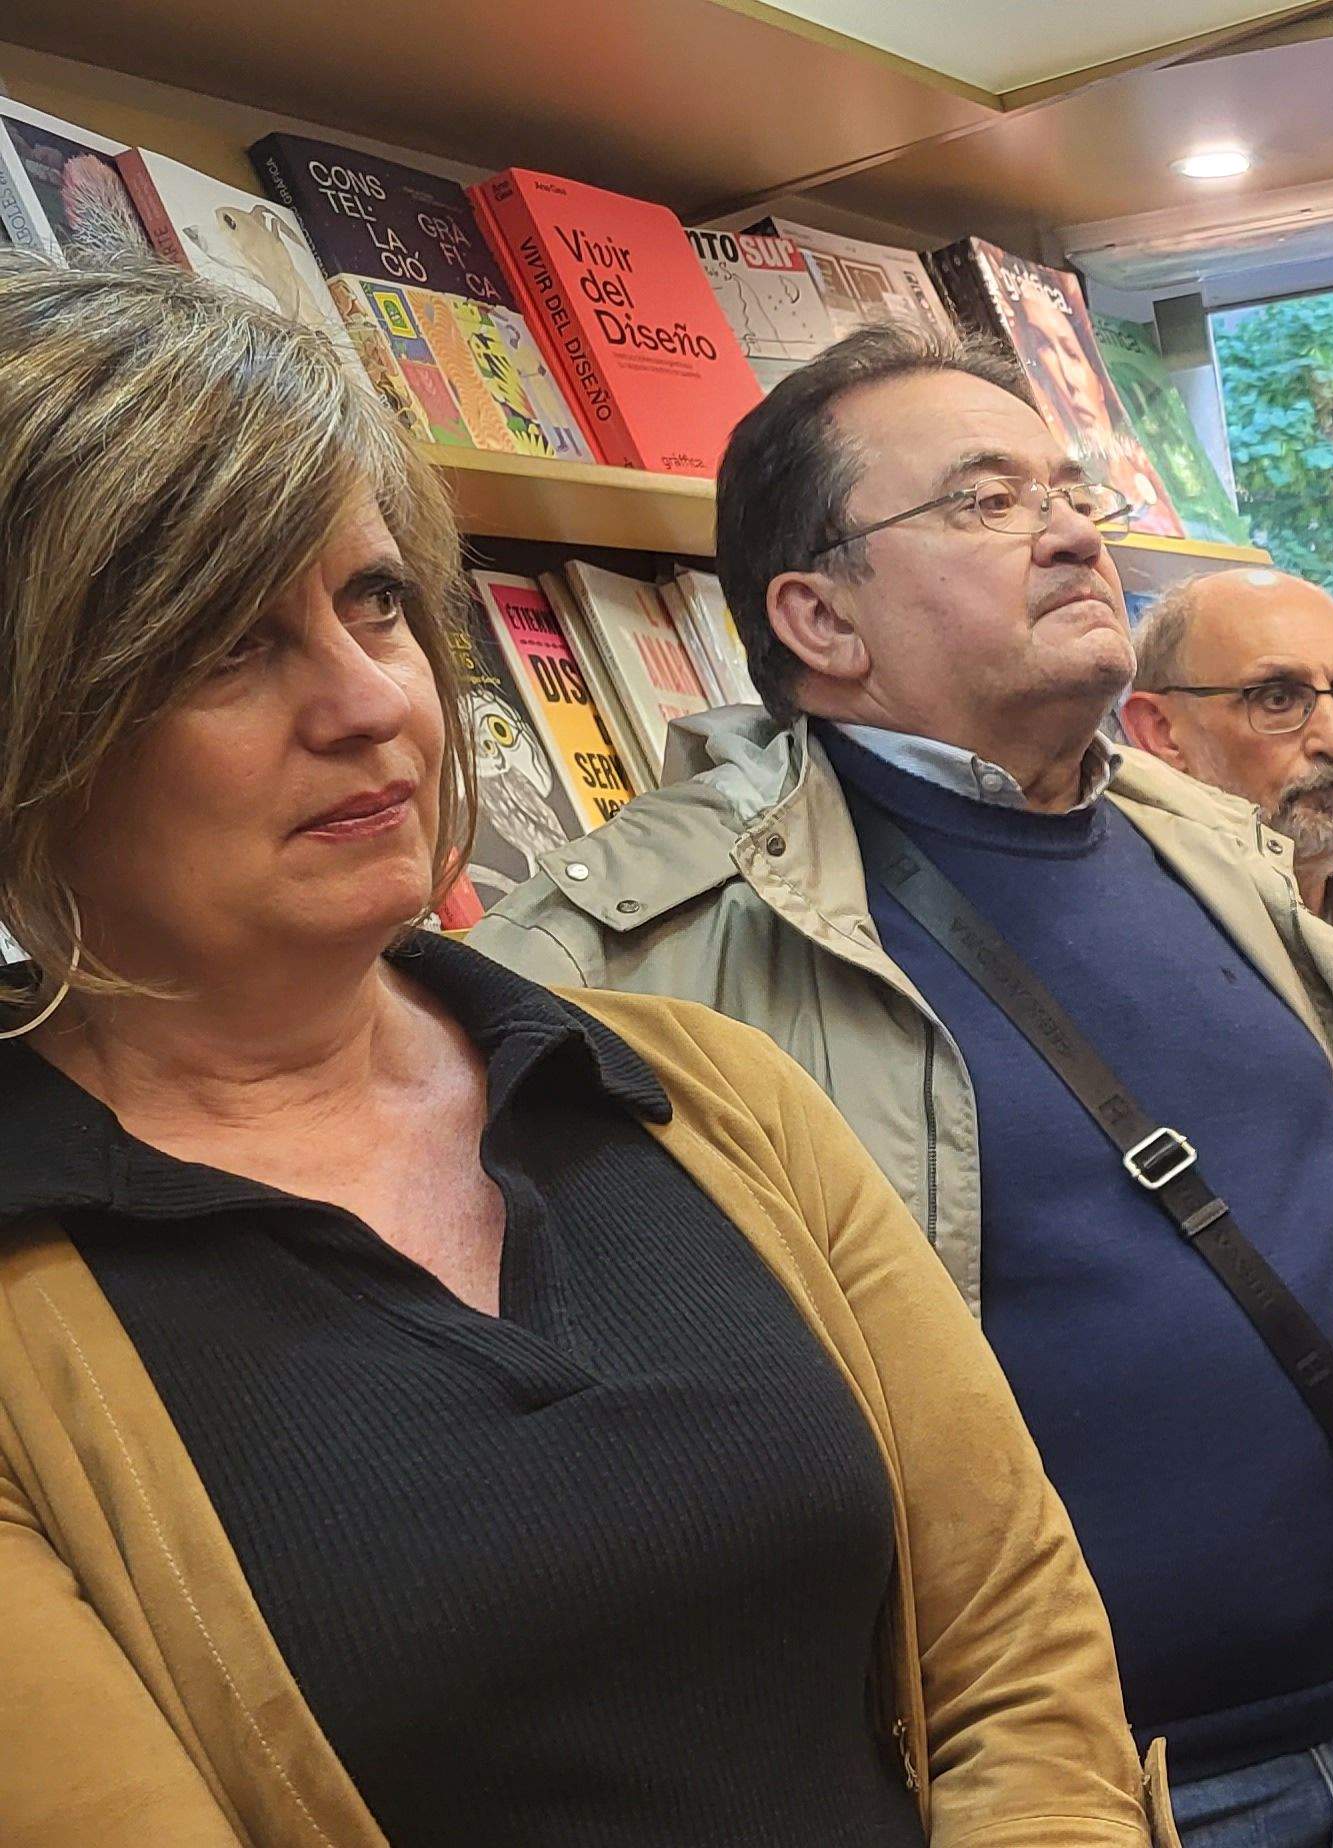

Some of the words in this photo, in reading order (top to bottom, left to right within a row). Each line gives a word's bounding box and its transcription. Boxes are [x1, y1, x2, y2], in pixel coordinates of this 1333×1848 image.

[308, 160, 387, 201] CONS
[367, 222, 408, 254] LA
[417, 211, 472, 248] GRÀ
[554, 225, 634, 273] Vivir
[380, 250, 428, 283] CIÓ
[741, 236, 795, 268] sur
[465, 272, 502, 299] CA
[580, 268, 635, 309] del
[520, 236, 553, 293] VIVIR
[545, 293, 572, 336] DEL
[564, 336, 613, 422] DISEÑO
[593, 308, 718, 361] Diseño
